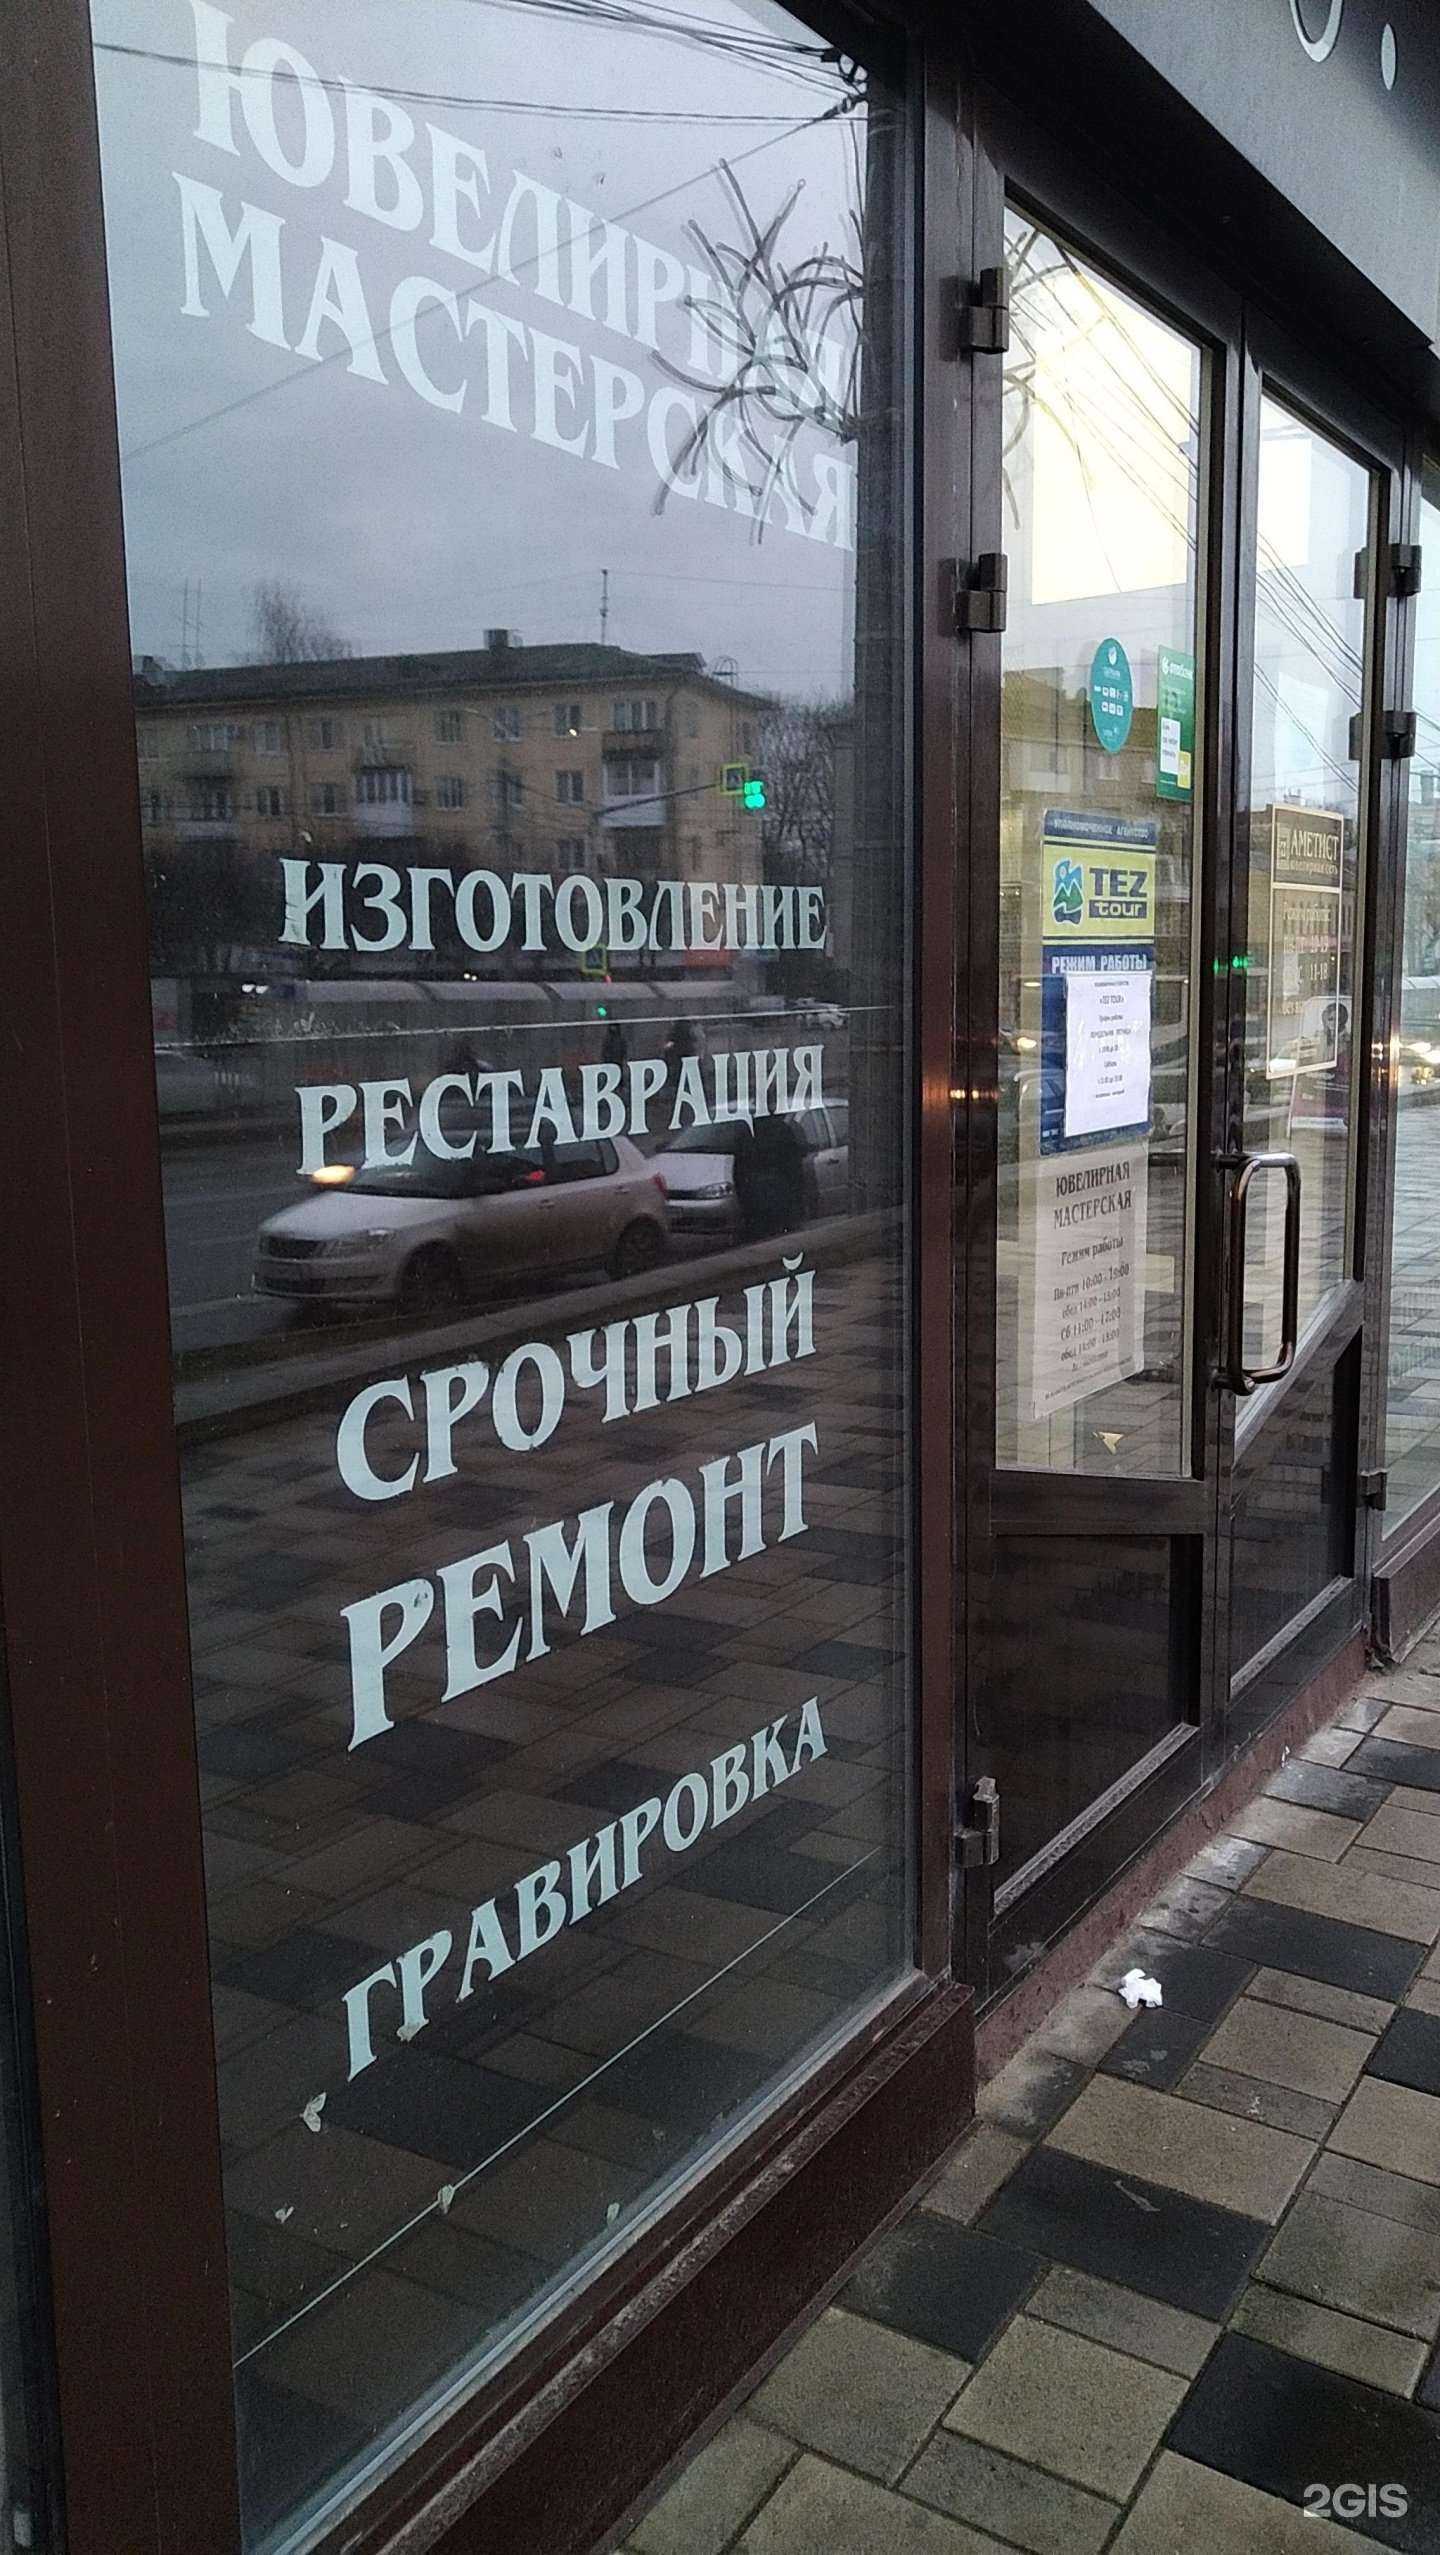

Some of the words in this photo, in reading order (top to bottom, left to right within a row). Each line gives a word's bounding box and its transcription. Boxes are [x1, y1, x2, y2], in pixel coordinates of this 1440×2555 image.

[172, 170, 858, 552] МАСТЕРСКАЯ
[1290, 829, 1340, 861] АМЕТИСТ
[279, 857, 829, 953] ИЗГОТОВЛЕНИЕ
[1089, 867, 1148, 898] TEZ
[1095, 902, 1143, 917] tour
[1052, 956, 1096, 974] РЕЖИМ
[1100, 954, 1148, 972] РАБОТЫ
[294, 1044, 825, 1176] РЕСТАВРАЦИЯ
[1054, 1189, 1132, 1229] МАСТЕРСКАЯ
[1055, 1161, 1130, 1198] ЮВЕЛИРНАЯ
[336, 1251, 817, 1502] СРОЧНЫЙ
[340, 1420, 818, 1752] РЕМОНТ
[342, 1695, 829, 2082] ГРАВИРОВКА
